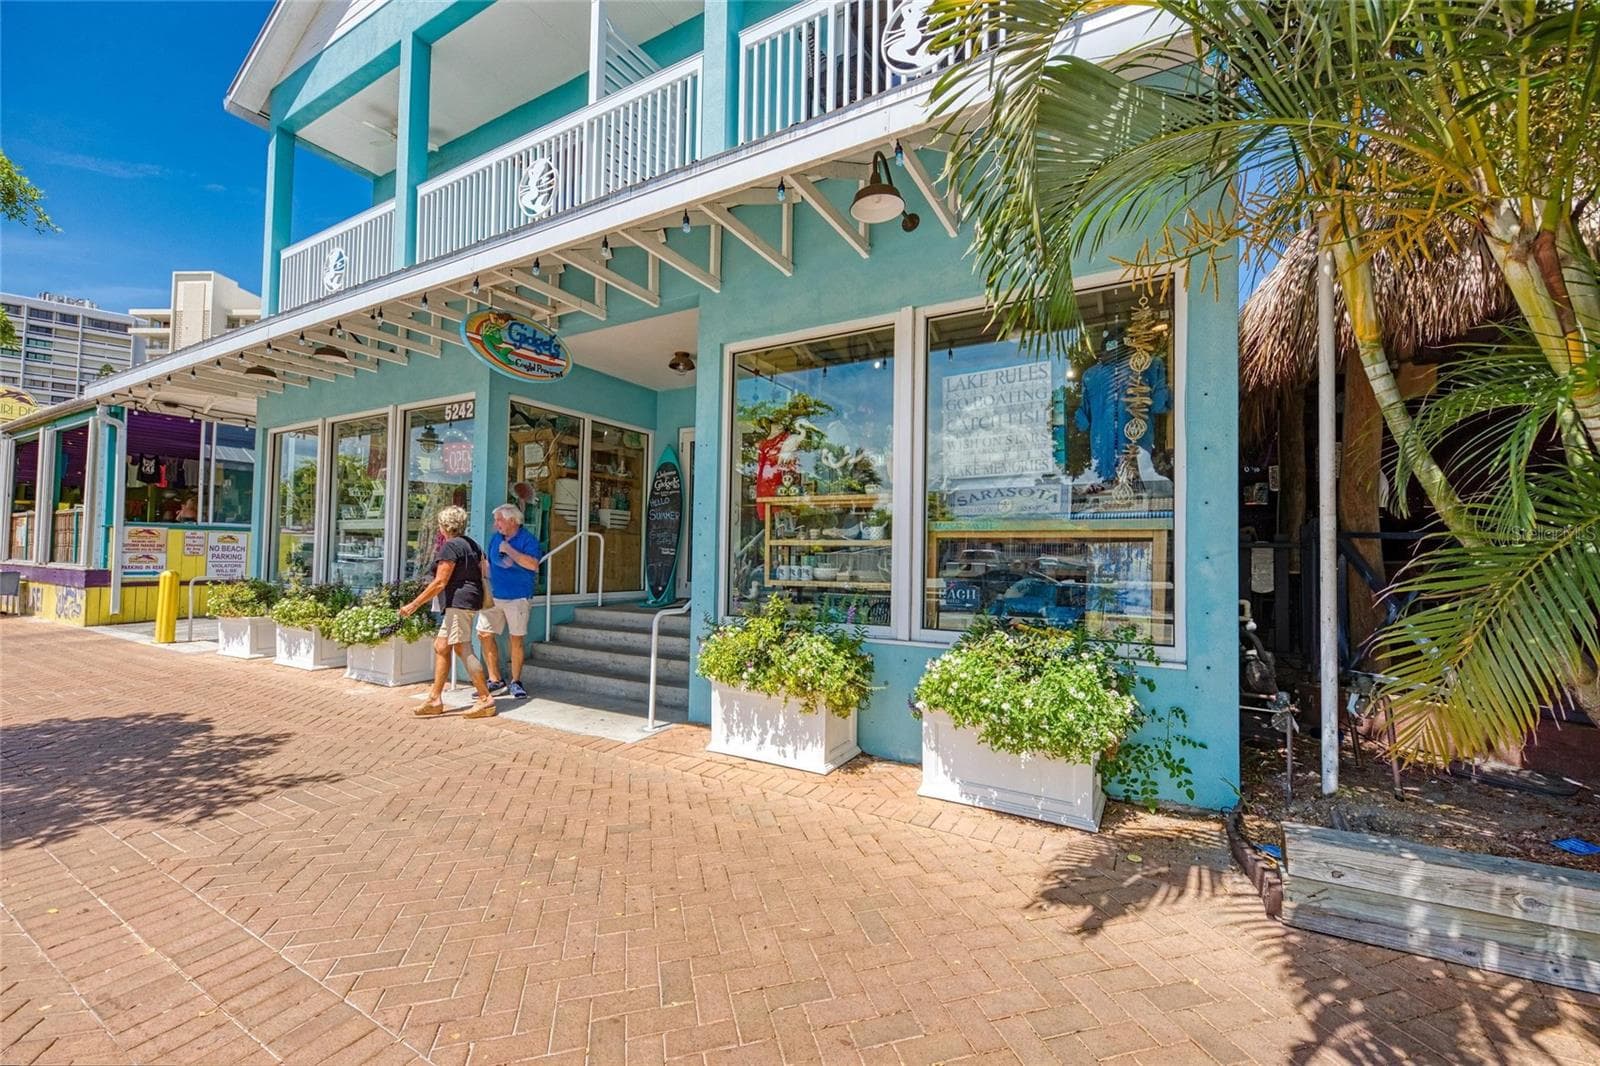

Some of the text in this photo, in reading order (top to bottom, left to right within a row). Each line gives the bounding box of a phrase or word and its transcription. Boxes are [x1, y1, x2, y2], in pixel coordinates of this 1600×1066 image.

[507, 321, 562, 358] Gidget's
[946, 373, 991, 393] LAKE
[995, 363, 1048, 386] RULES
[945, 398, 969, 411] GO
[973, 388, 1047, 409] BOATING
[445, 401, 474, 420] 5242
[956, 487, 1058, 507] SARASOTA
[222, 545, 245, 553] BEACH
